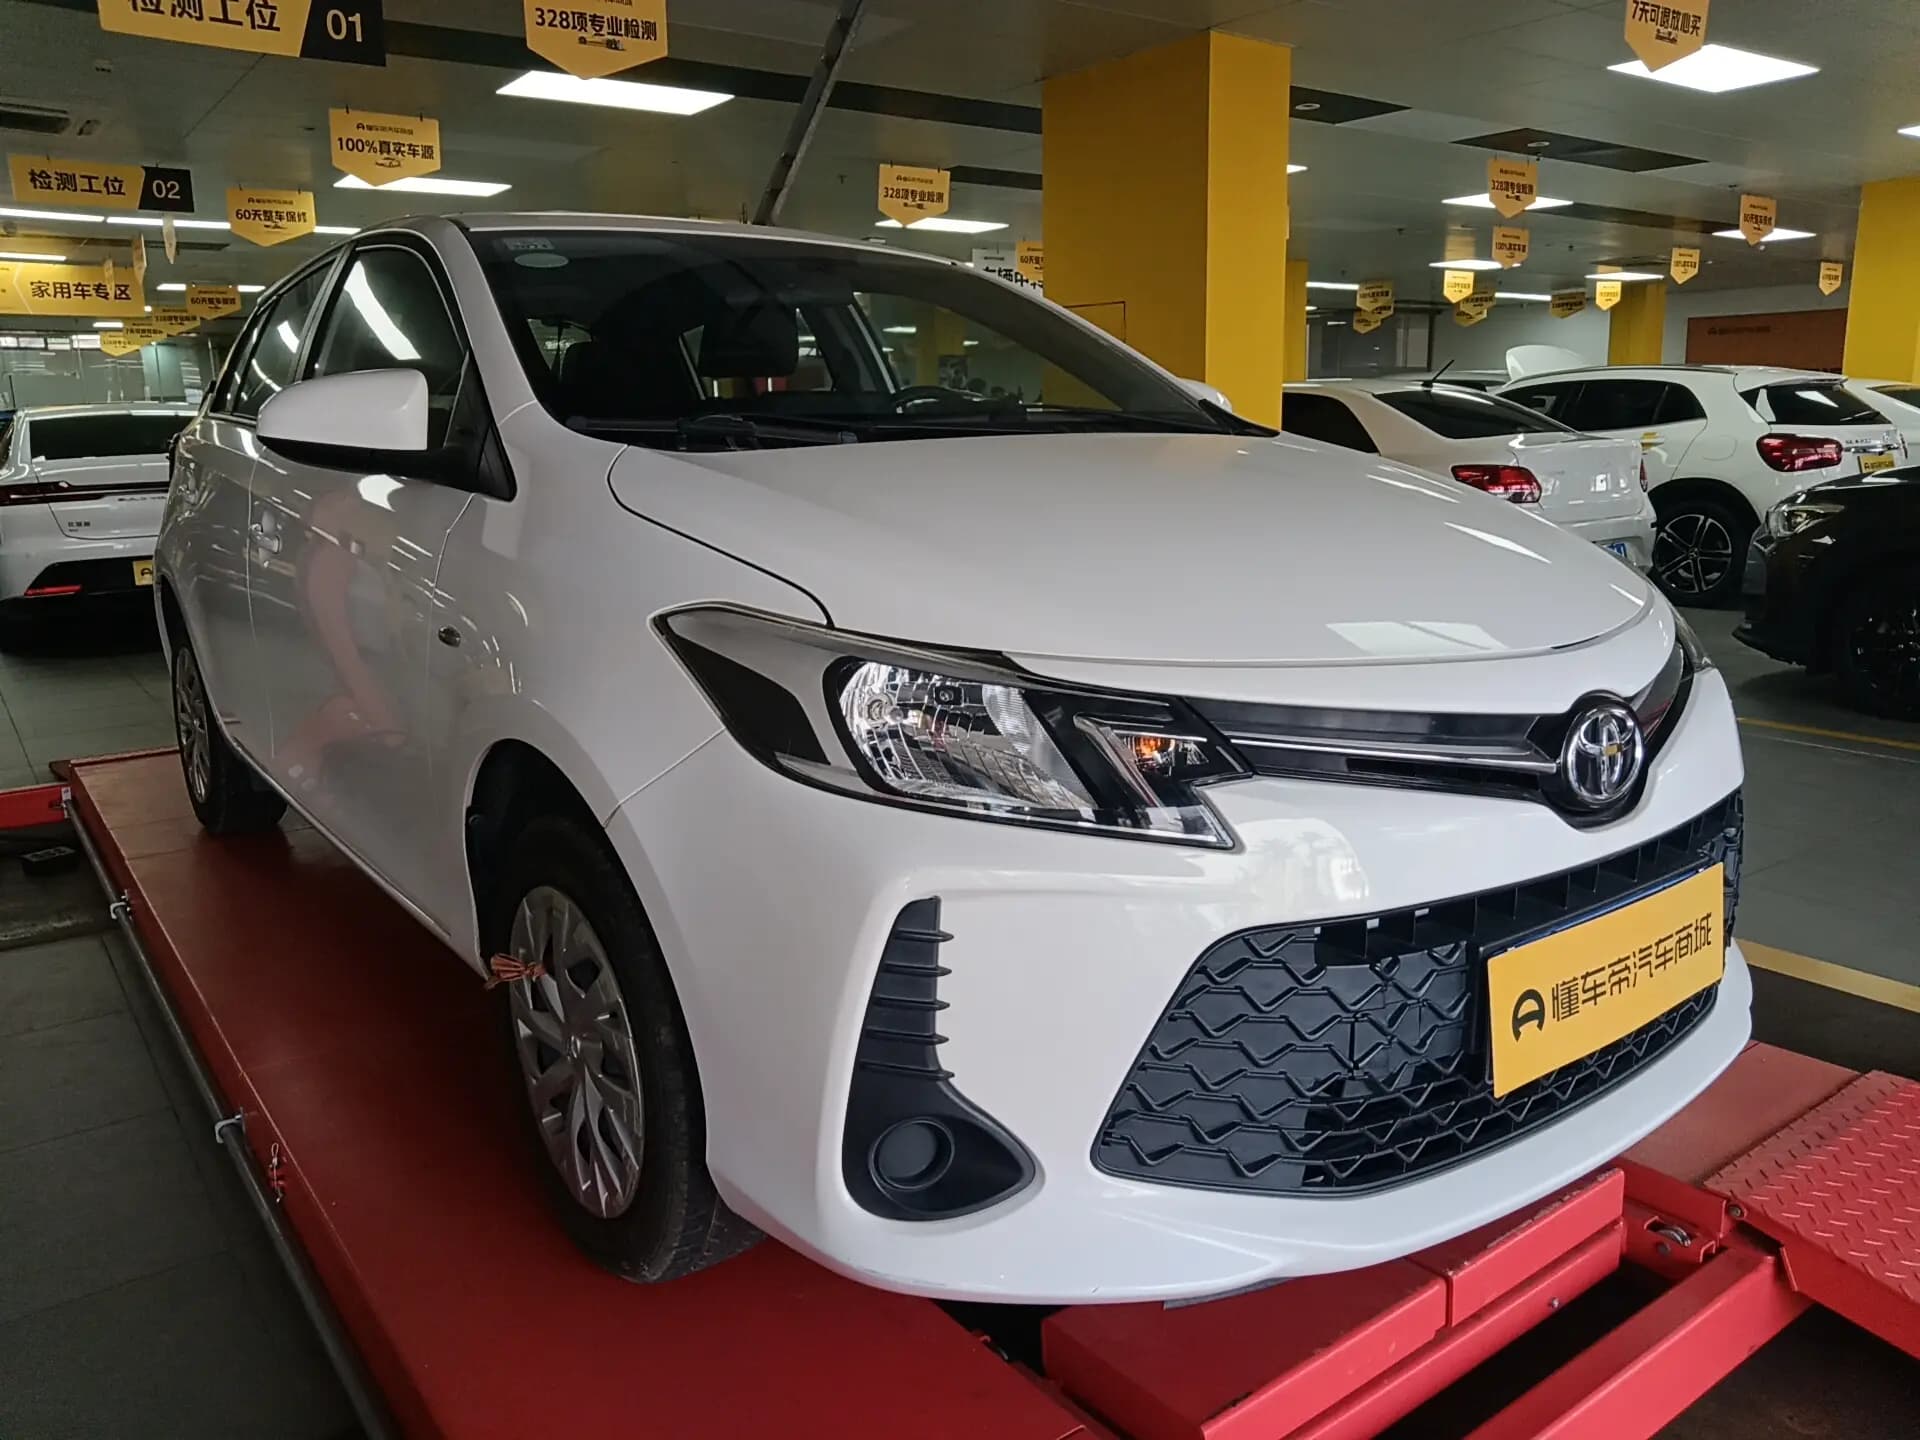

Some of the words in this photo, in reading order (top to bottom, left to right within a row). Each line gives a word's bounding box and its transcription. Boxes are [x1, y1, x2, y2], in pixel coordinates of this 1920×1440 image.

[326, 9, 363, 42] 01
[535, 8, 657, 41] 328项专业检测
[1632, 0, 1702, 37] 7天可退放心买
[337, 137, 435, 160] 100%真实车源
[29, 168, 126, 196] 检测工位
[152, 179, 181, 200] 02
[30, 280, 132, 301] 家用车专区
[1551, 911, 1712, 1022] 懂车帝汽车商城
